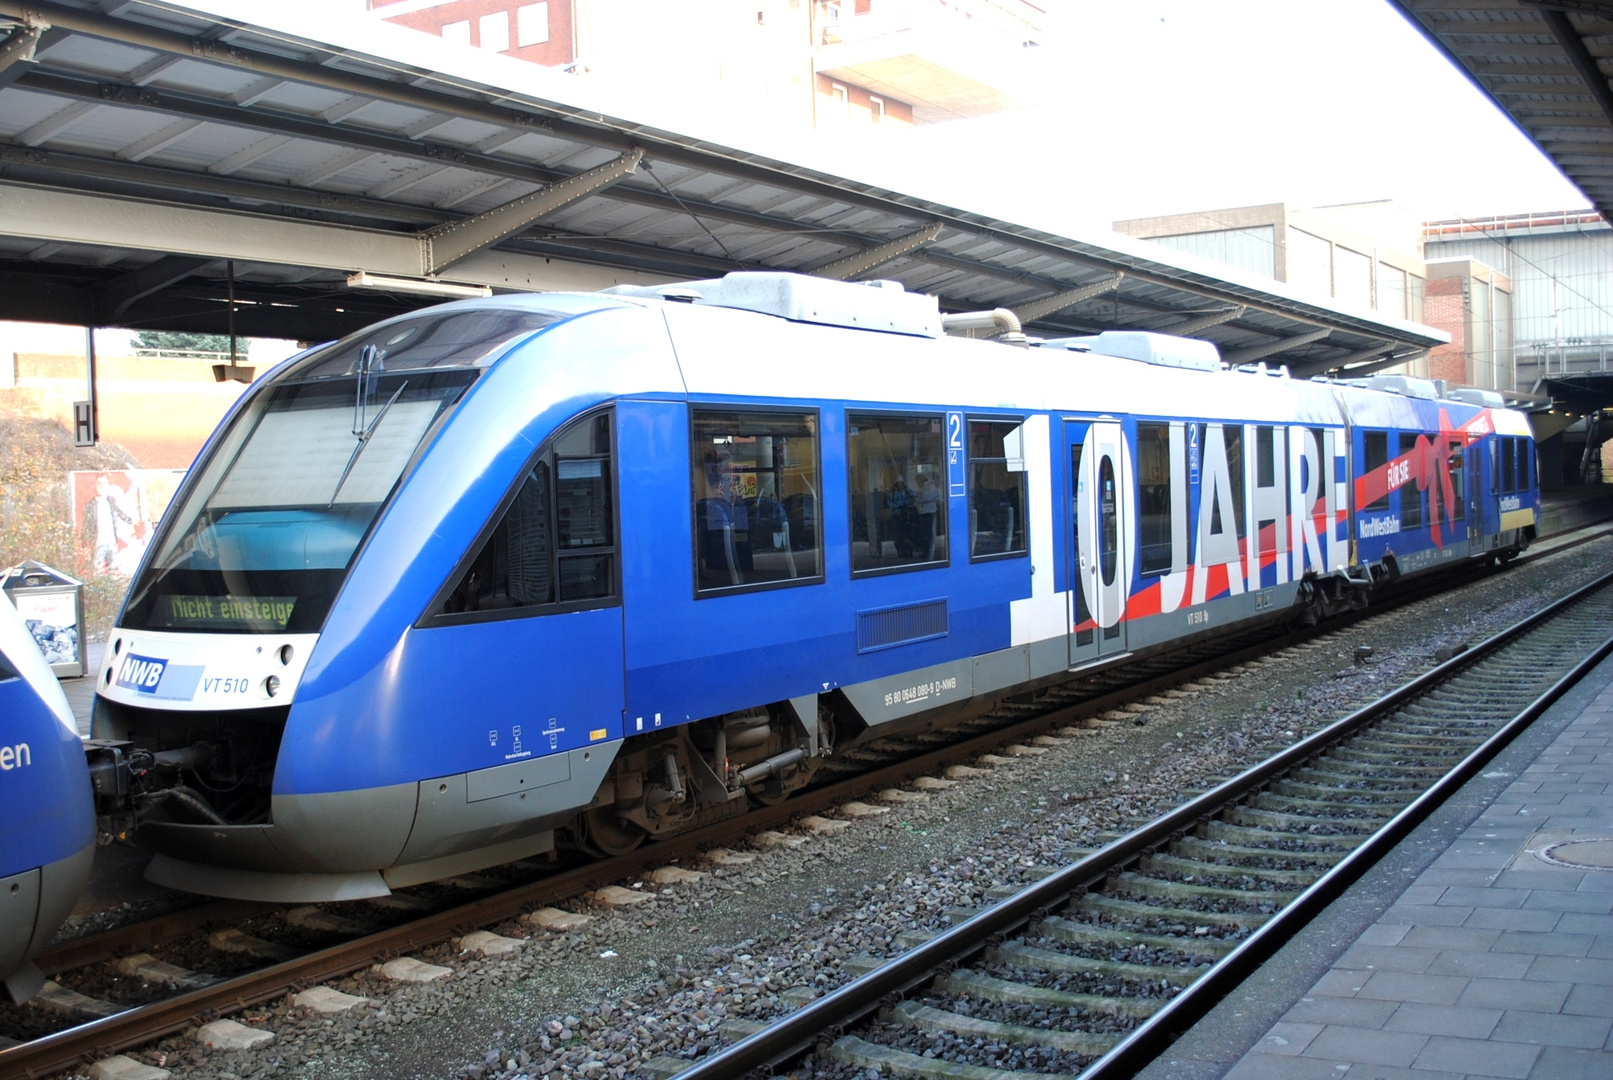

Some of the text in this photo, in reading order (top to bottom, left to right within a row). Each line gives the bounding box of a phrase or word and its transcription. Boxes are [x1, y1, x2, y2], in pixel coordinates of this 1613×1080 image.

[75, 404, 90, 442] H
[950, 414, 961, 447] 2
[1190, 423, 1197, 448] 2
[1387, 460, 1409, 490] FÜR SIE
[1003, 415, 1348, 647] 10 JAHRE
[1359, 514, 1400, 539] NordWestBahn
[171, 595, 214, 619] Nicht
[119, 657, 164, 687] NWB
[203, 678, 249, 693] VT 510
[884, 677, 957, 706] 95 80 0648 080-9 D-NWB
